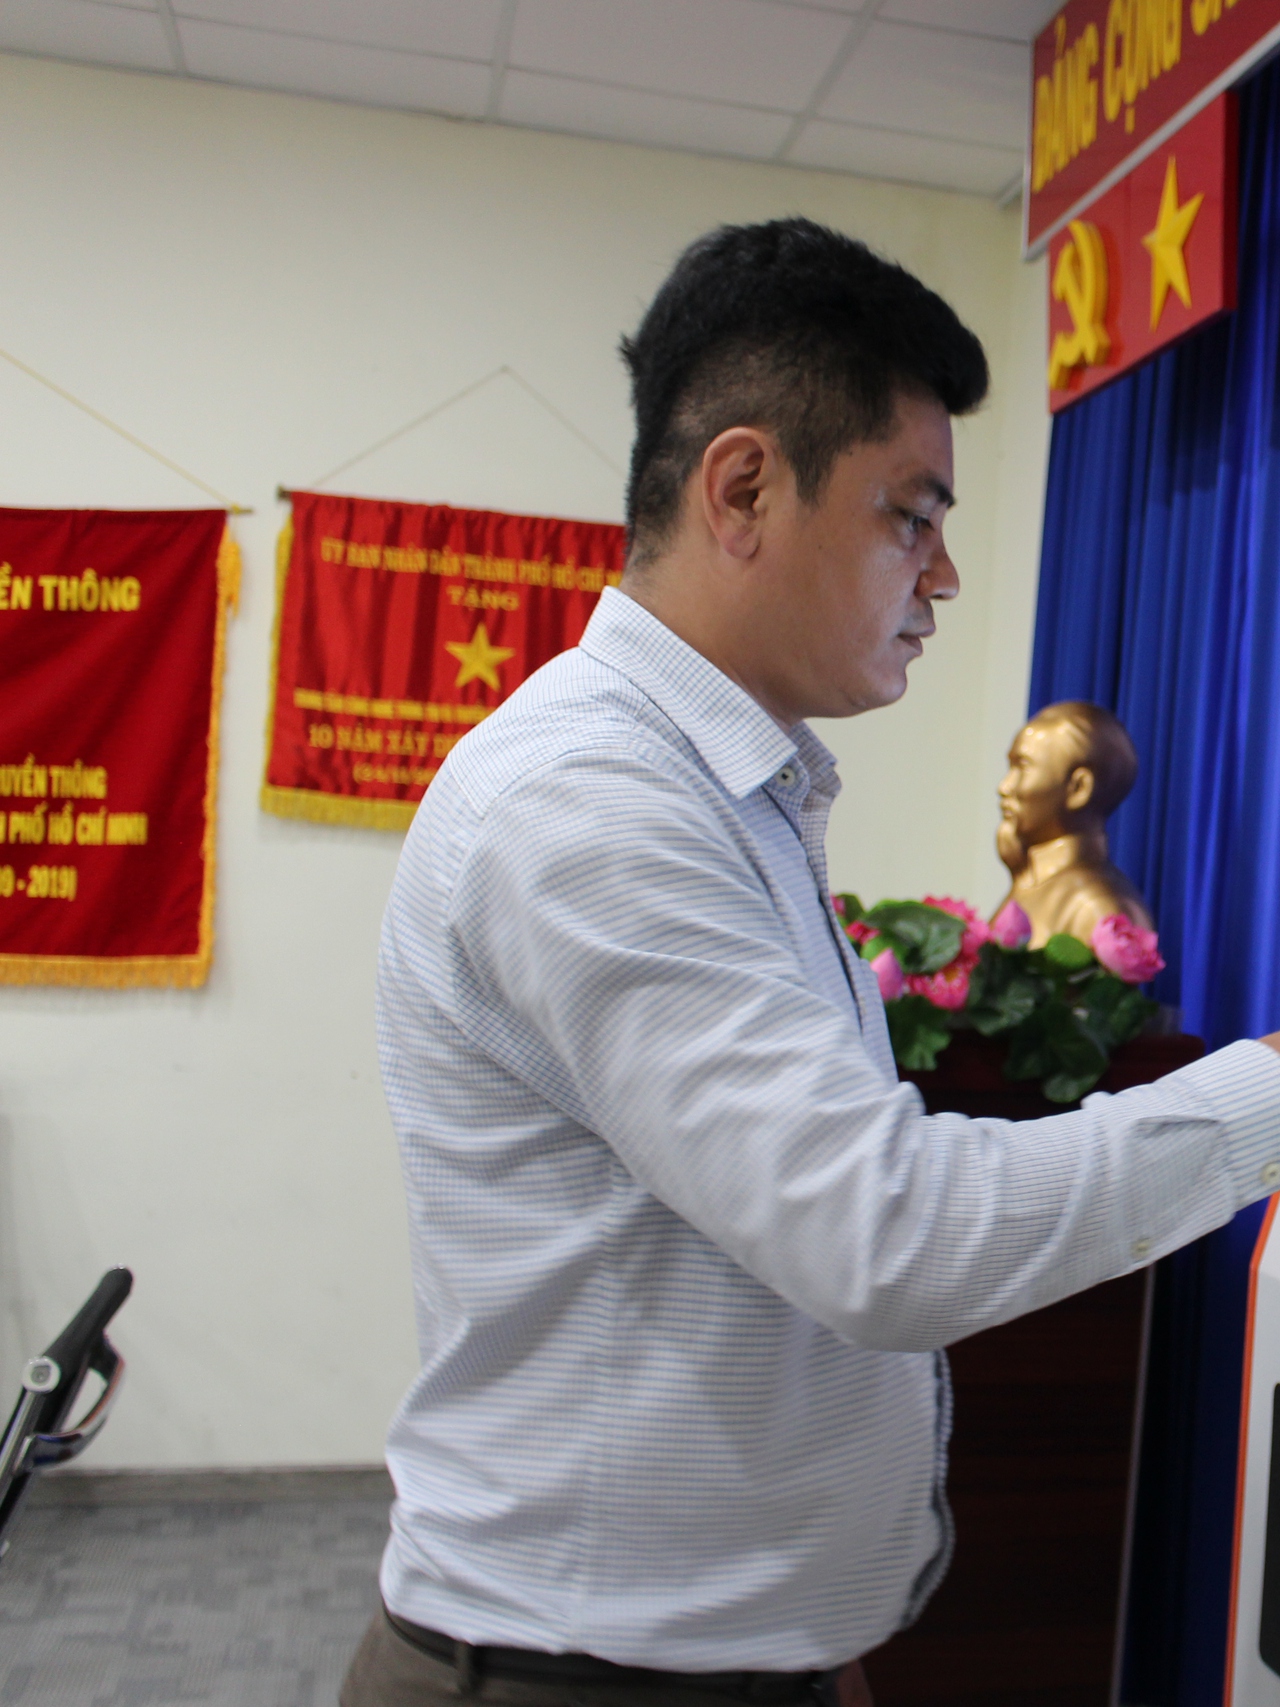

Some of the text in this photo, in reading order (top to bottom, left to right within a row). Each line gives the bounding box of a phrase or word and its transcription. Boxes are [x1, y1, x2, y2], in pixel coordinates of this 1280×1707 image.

[1031, 13, 1100, 194] ĐẢNG
[38, 567, 142, 612] THÔNG
[346, 541, 382, 569] BAN
[382, 541, 428, 574] NHÂN
[429, 544, 461, 577] DÂN
[463, 550, 517, 584] THÀNH
[518, 553, 551, 588] PHỐ
[551, 555, 576, 591] HỒ
[576, 561, 605, 593] CHÍ
[446, 584, 520, 611] TẶNG
[309, 723, 334, 749] 10
[336, 722, 384, 754] NĂM
[9, 800, 48, 844] PHỐ
[48, 800, 74, 845] HỒ
[76, 805, 108, 846] CHÍ
